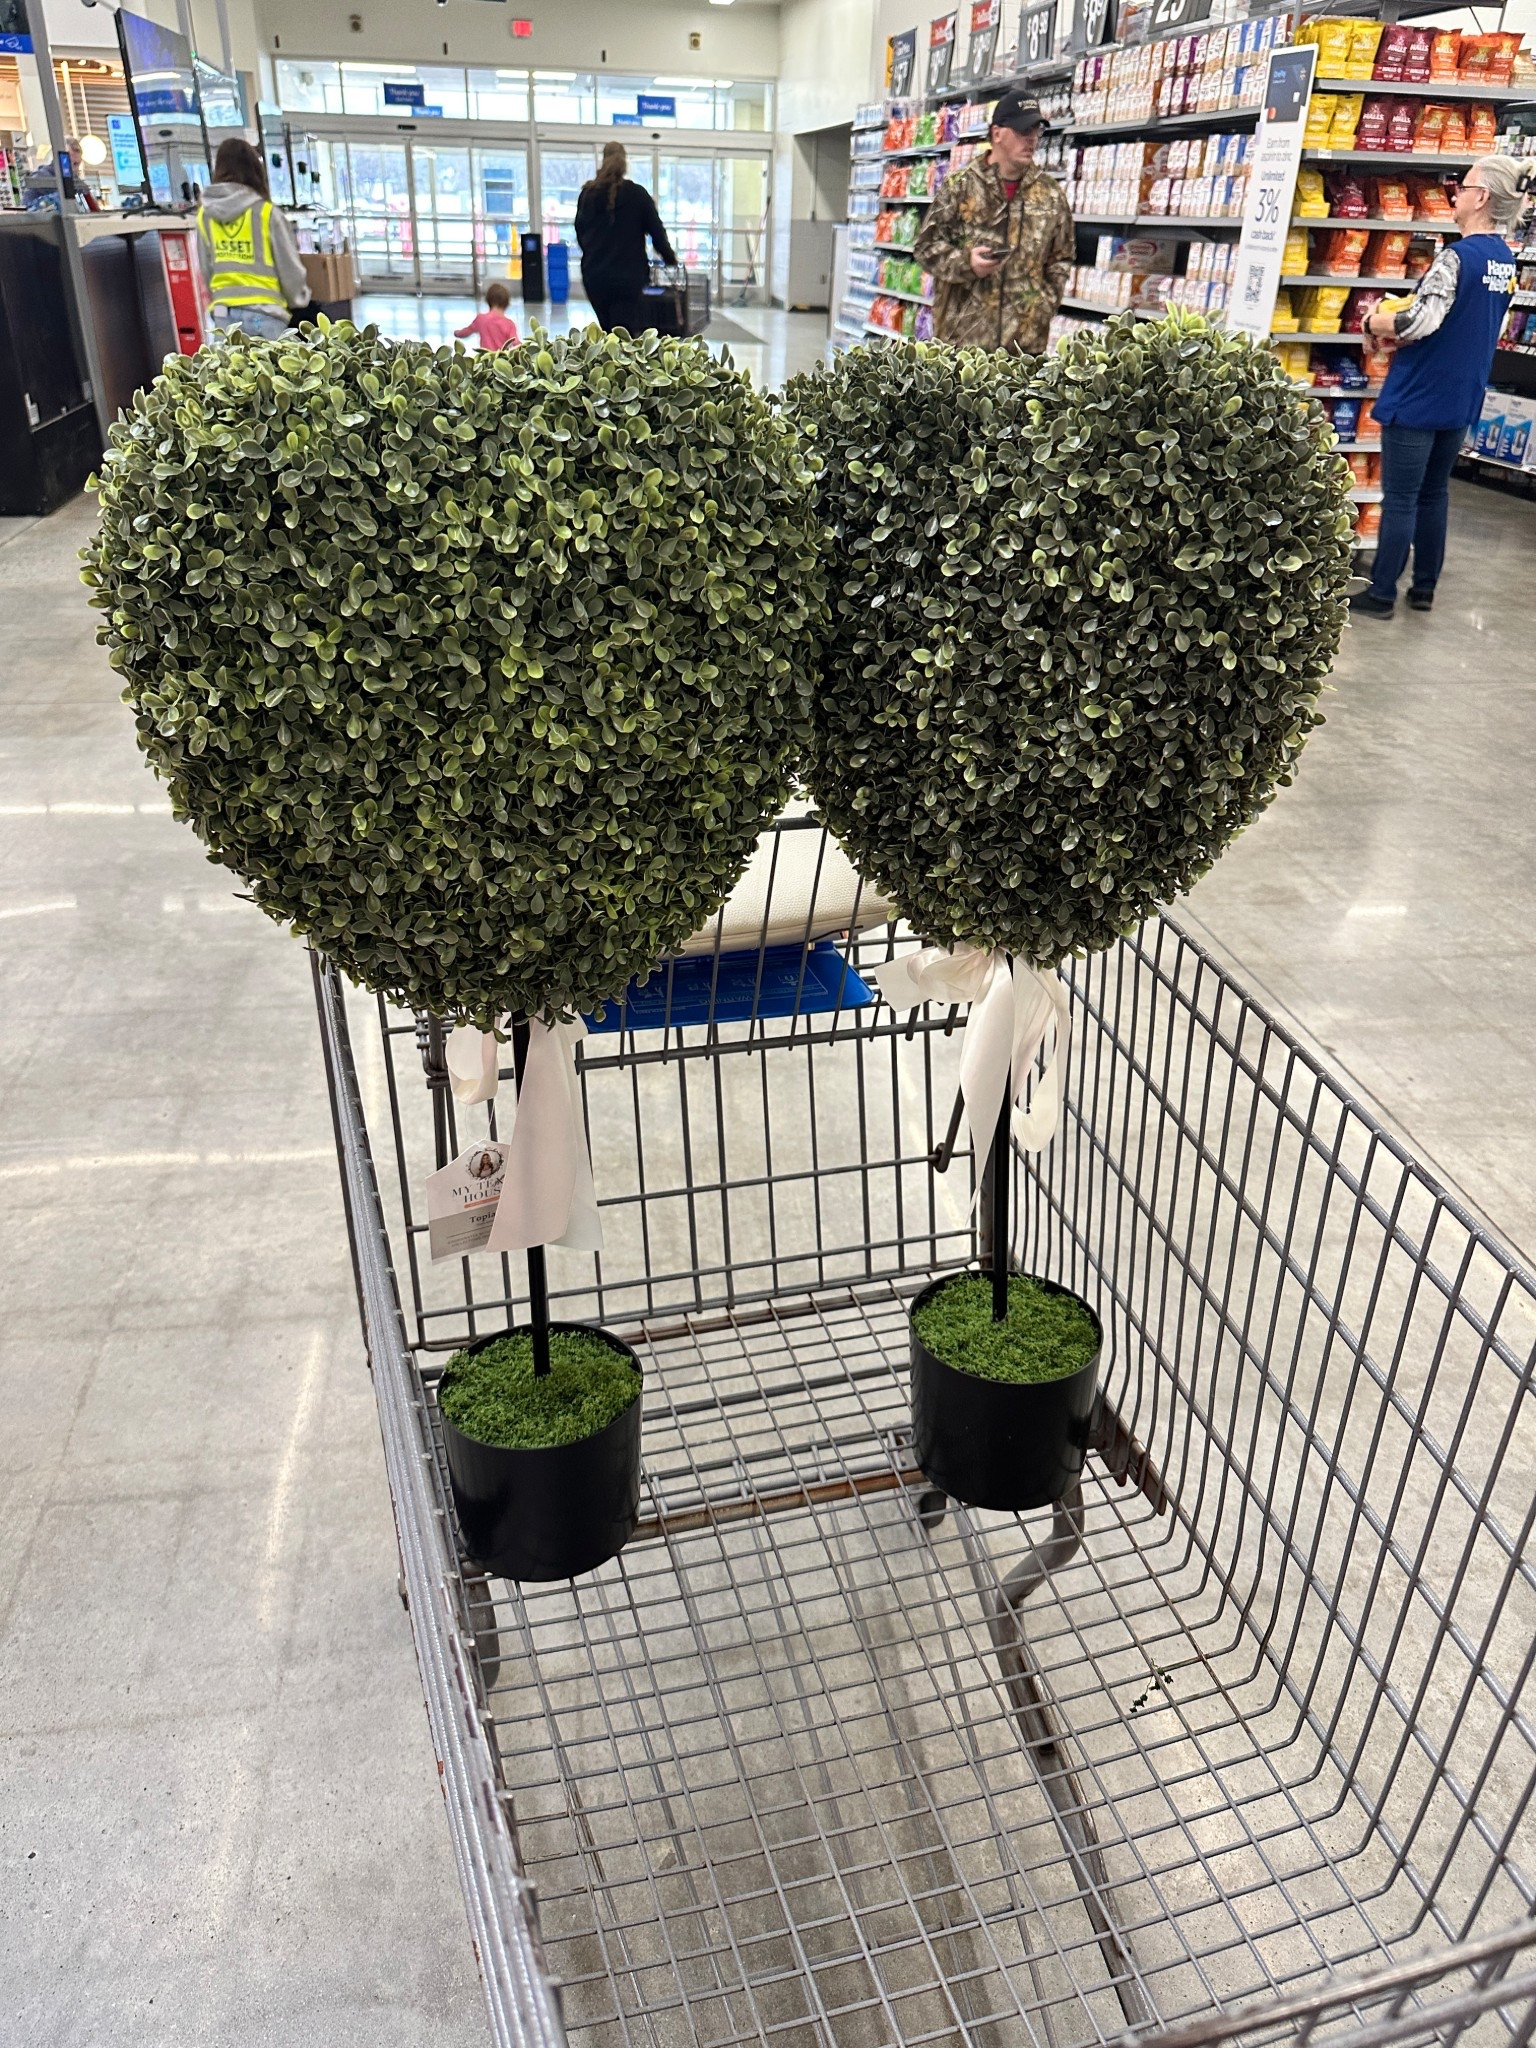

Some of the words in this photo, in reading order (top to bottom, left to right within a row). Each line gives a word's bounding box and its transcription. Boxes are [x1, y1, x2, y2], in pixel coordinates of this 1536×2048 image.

[1410, 43, 1429, 52] HALLS
[1261, 171, 1285, 181] Unlimited
[1255, 188, 1281, 224] 3%
[1487, 259, 1516, 279] Happy
[1488, 276, 1510, 294] Help
[452, 1184, 473, 1198] MY
